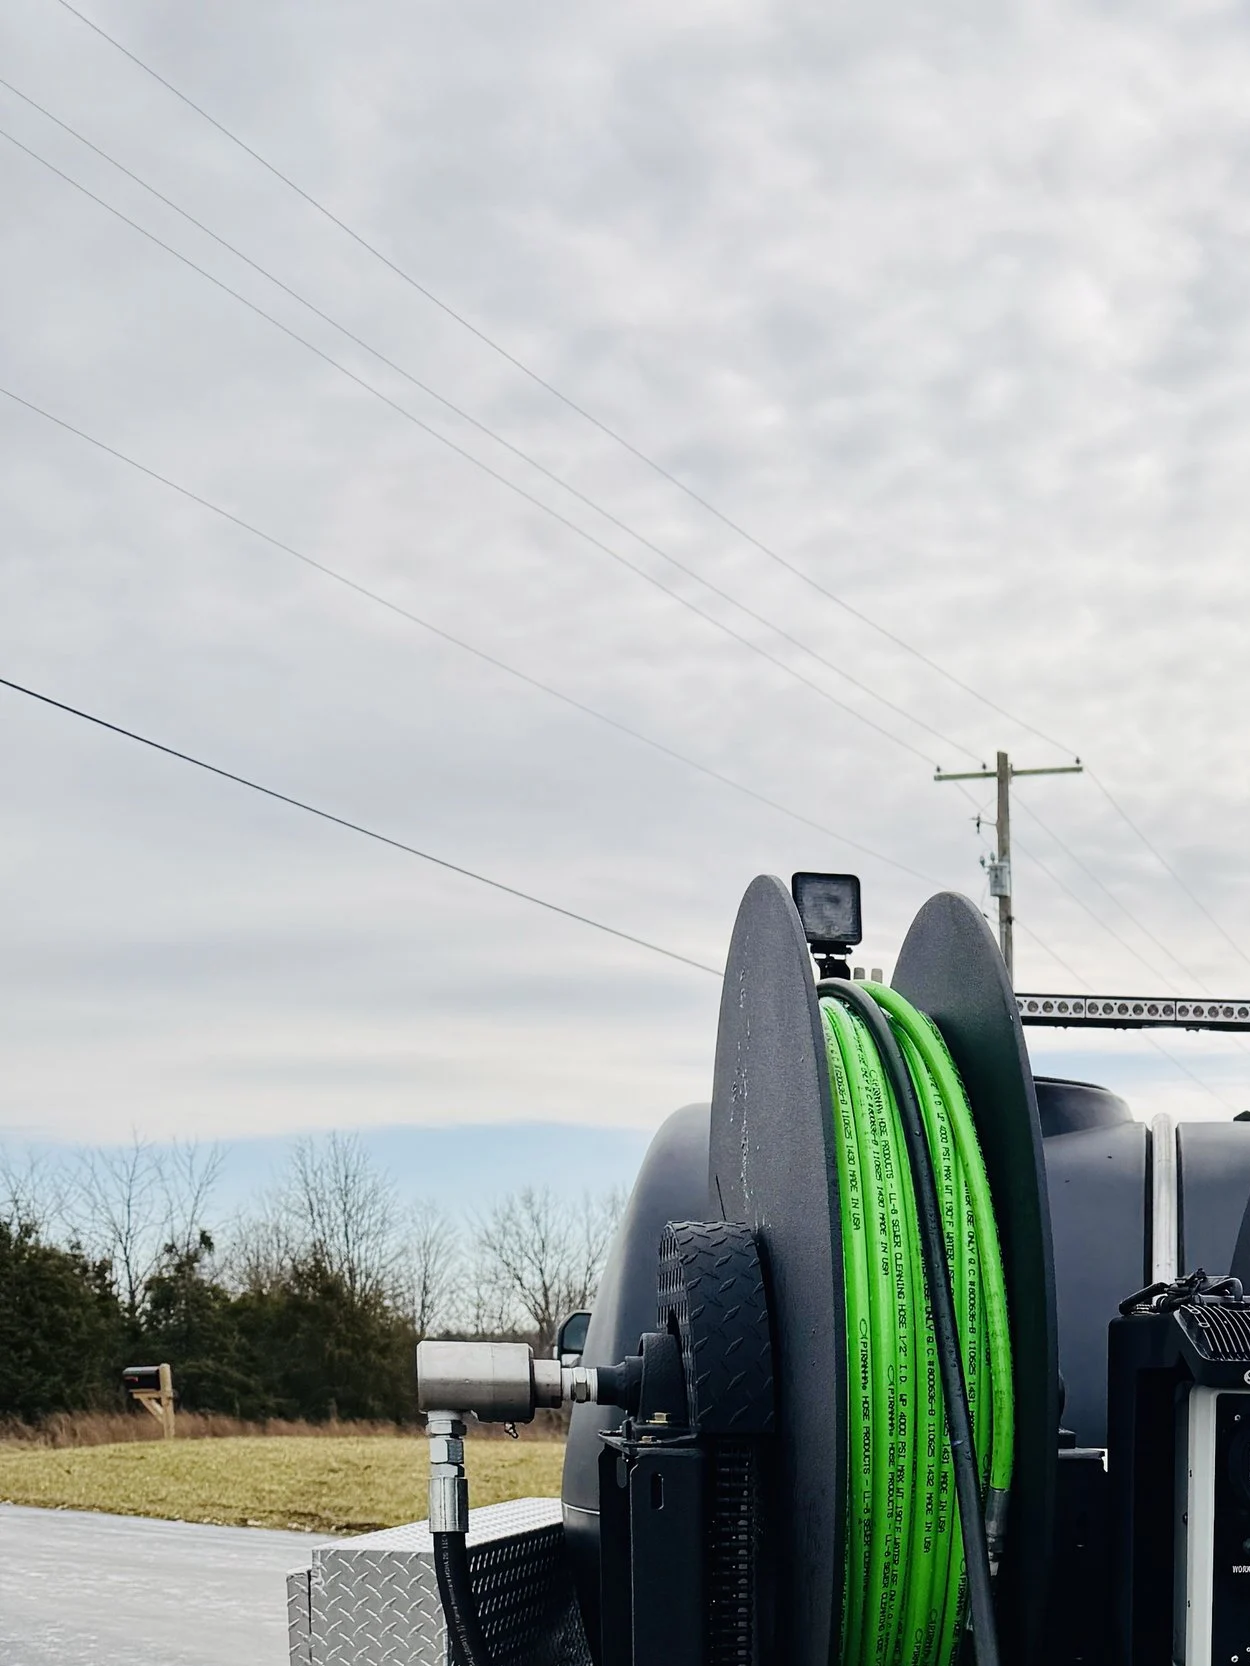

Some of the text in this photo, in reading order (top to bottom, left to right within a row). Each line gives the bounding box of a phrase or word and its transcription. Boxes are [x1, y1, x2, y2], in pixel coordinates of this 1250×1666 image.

[880, 1140, 894, 1178] PRODUCTS
[851, 1198, 859, 1209] IN
[892, 1219, 902, 1248] SEWER
[881, 1242, 888, 1253] IN
[895, 1252, 906, 1299] CLEANING
[898, 1304, 906, 1329] HOSE
[862, 1396, 870, 1421] HOSE
[899, 1394, 907, 1406] WP
[898, 1442, 906, 1459] PSI
[939, 1501, 948, 1512] IN
[925, 1522, 932, 1532] IN
[938, 1516, 946, 1533] USA
[1232, 1565, 1250, 1573] WORK
